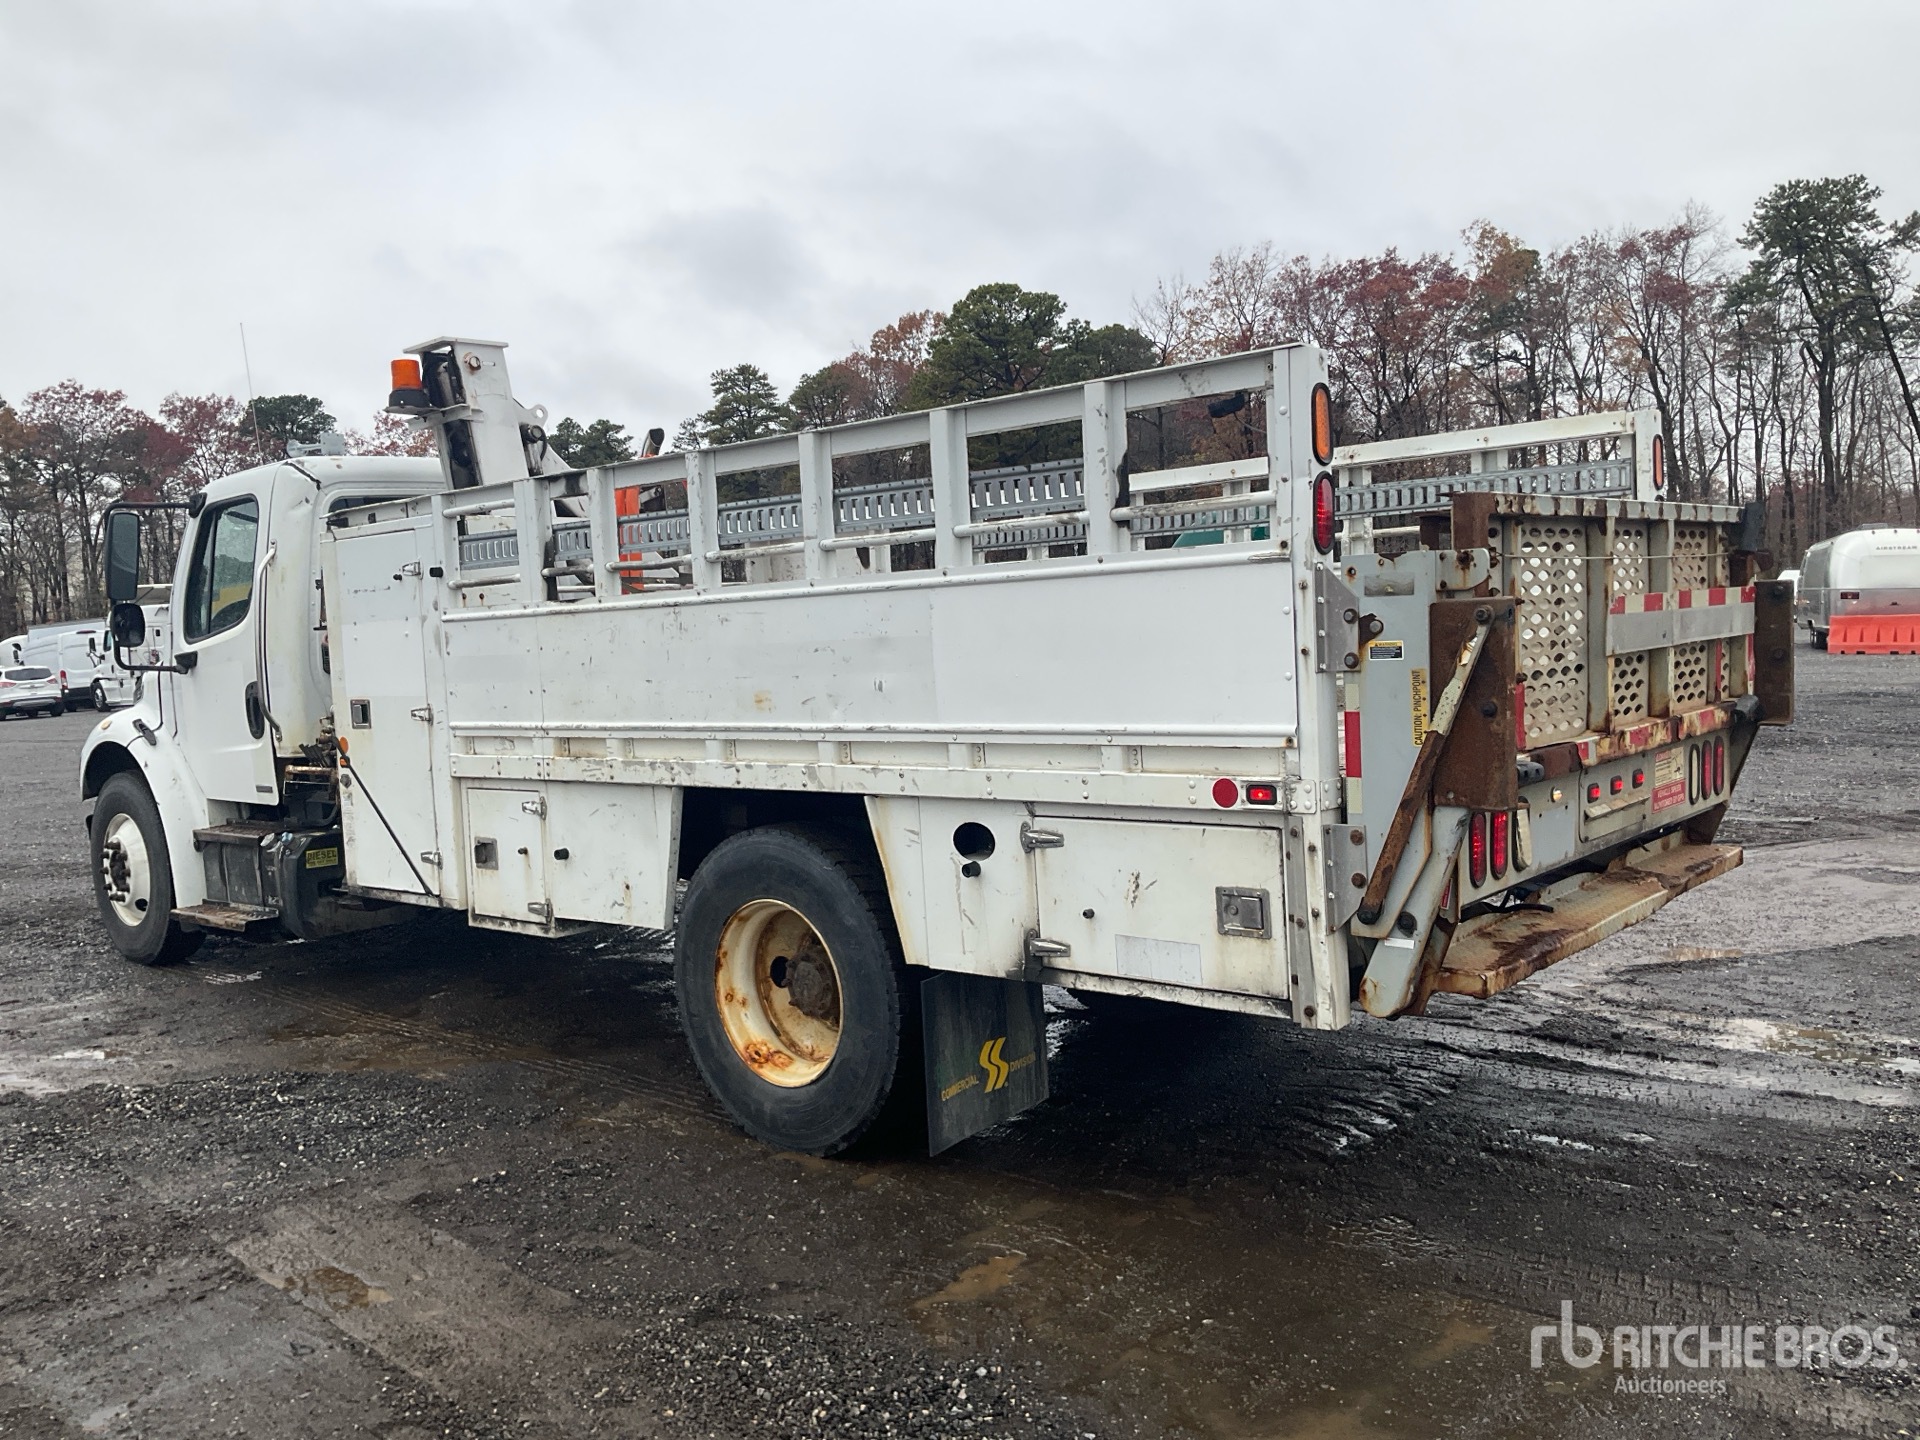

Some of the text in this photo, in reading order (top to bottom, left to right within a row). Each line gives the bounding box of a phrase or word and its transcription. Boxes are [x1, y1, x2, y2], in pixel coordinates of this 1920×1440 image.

[1411, 670, 1423, 712] PINCHPOINT
[307, 850, 337, 861] DIESEL
[941, 1052, 1037, 1102] COMMERCIAL DIVISION
